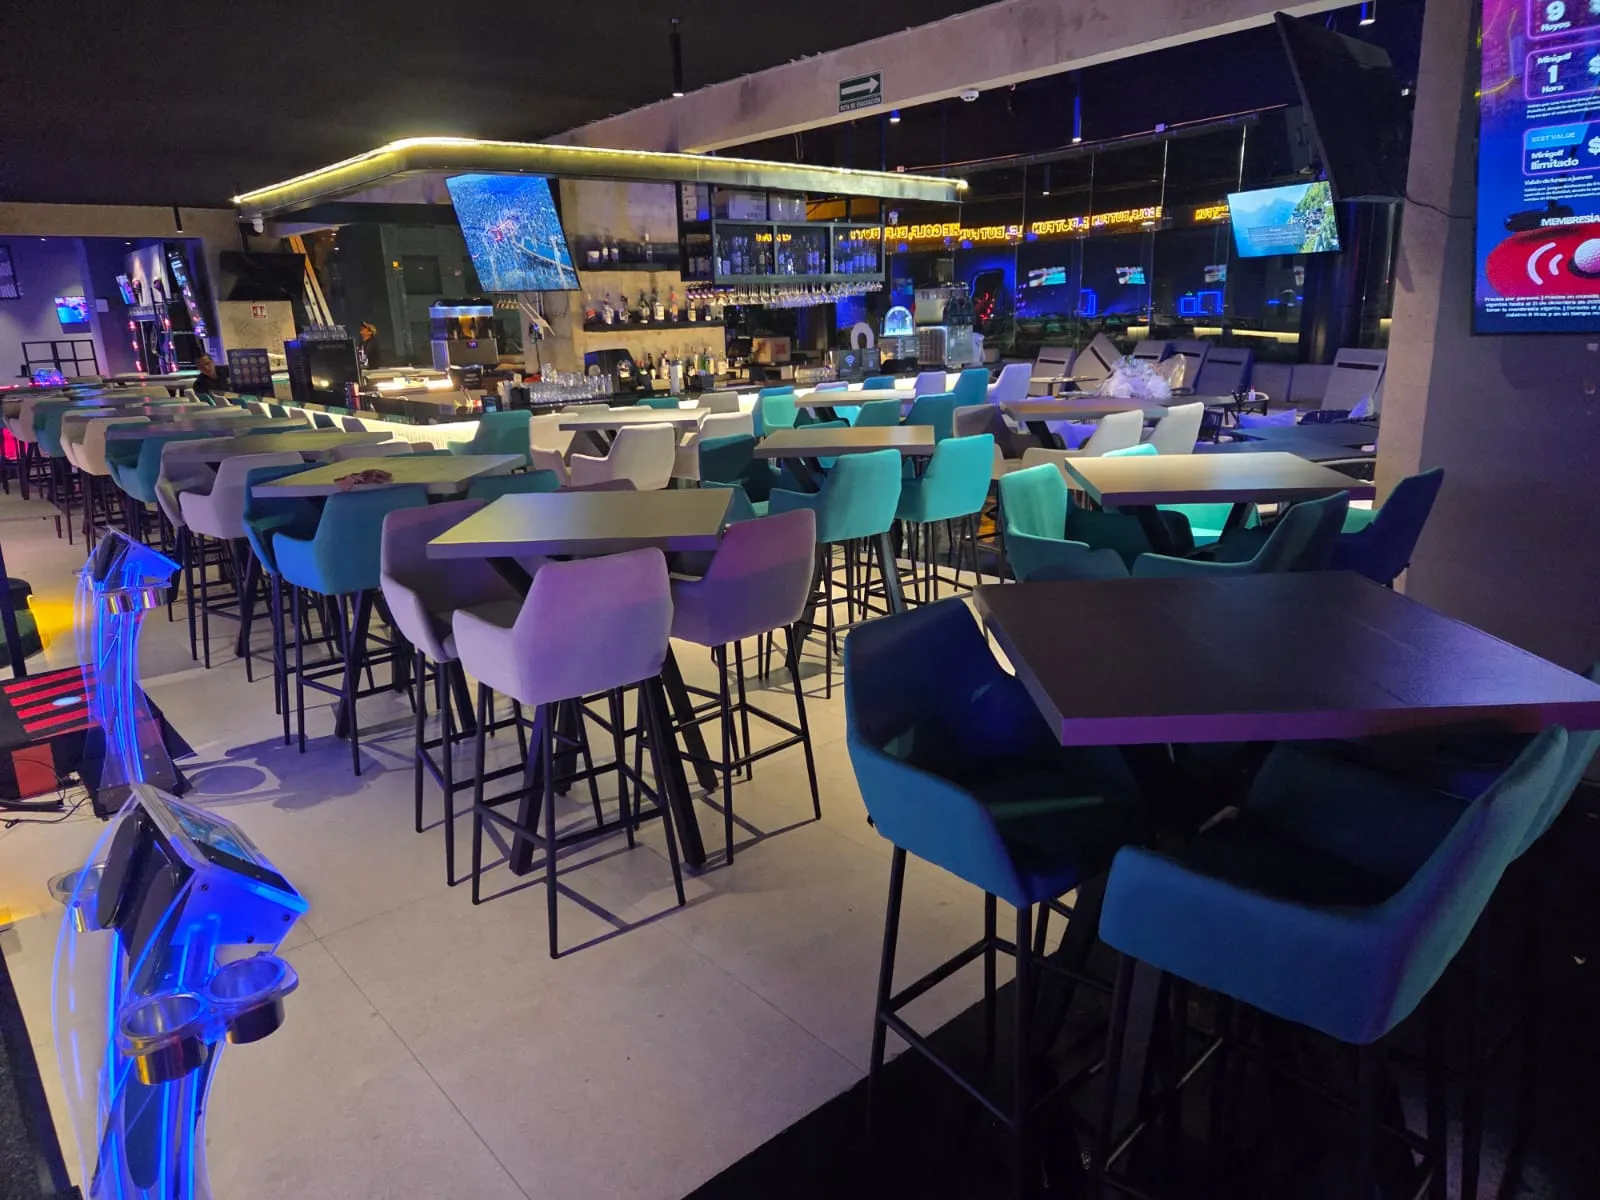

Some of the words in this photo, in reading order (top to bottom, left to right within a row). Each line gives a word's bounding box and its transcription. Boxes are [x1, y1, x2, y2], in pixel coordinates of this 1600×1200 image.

[1546, 0, 1566, 21] 9
[1541, 21, 1572, 32] Hoyos
[1547, 64, 1559, 84] 1
[1541, 84, 1565, 94] Hora
[1531, 149, 1564, 160] Minigolf
[1530, 157, 1579, 171] Ilimitado
